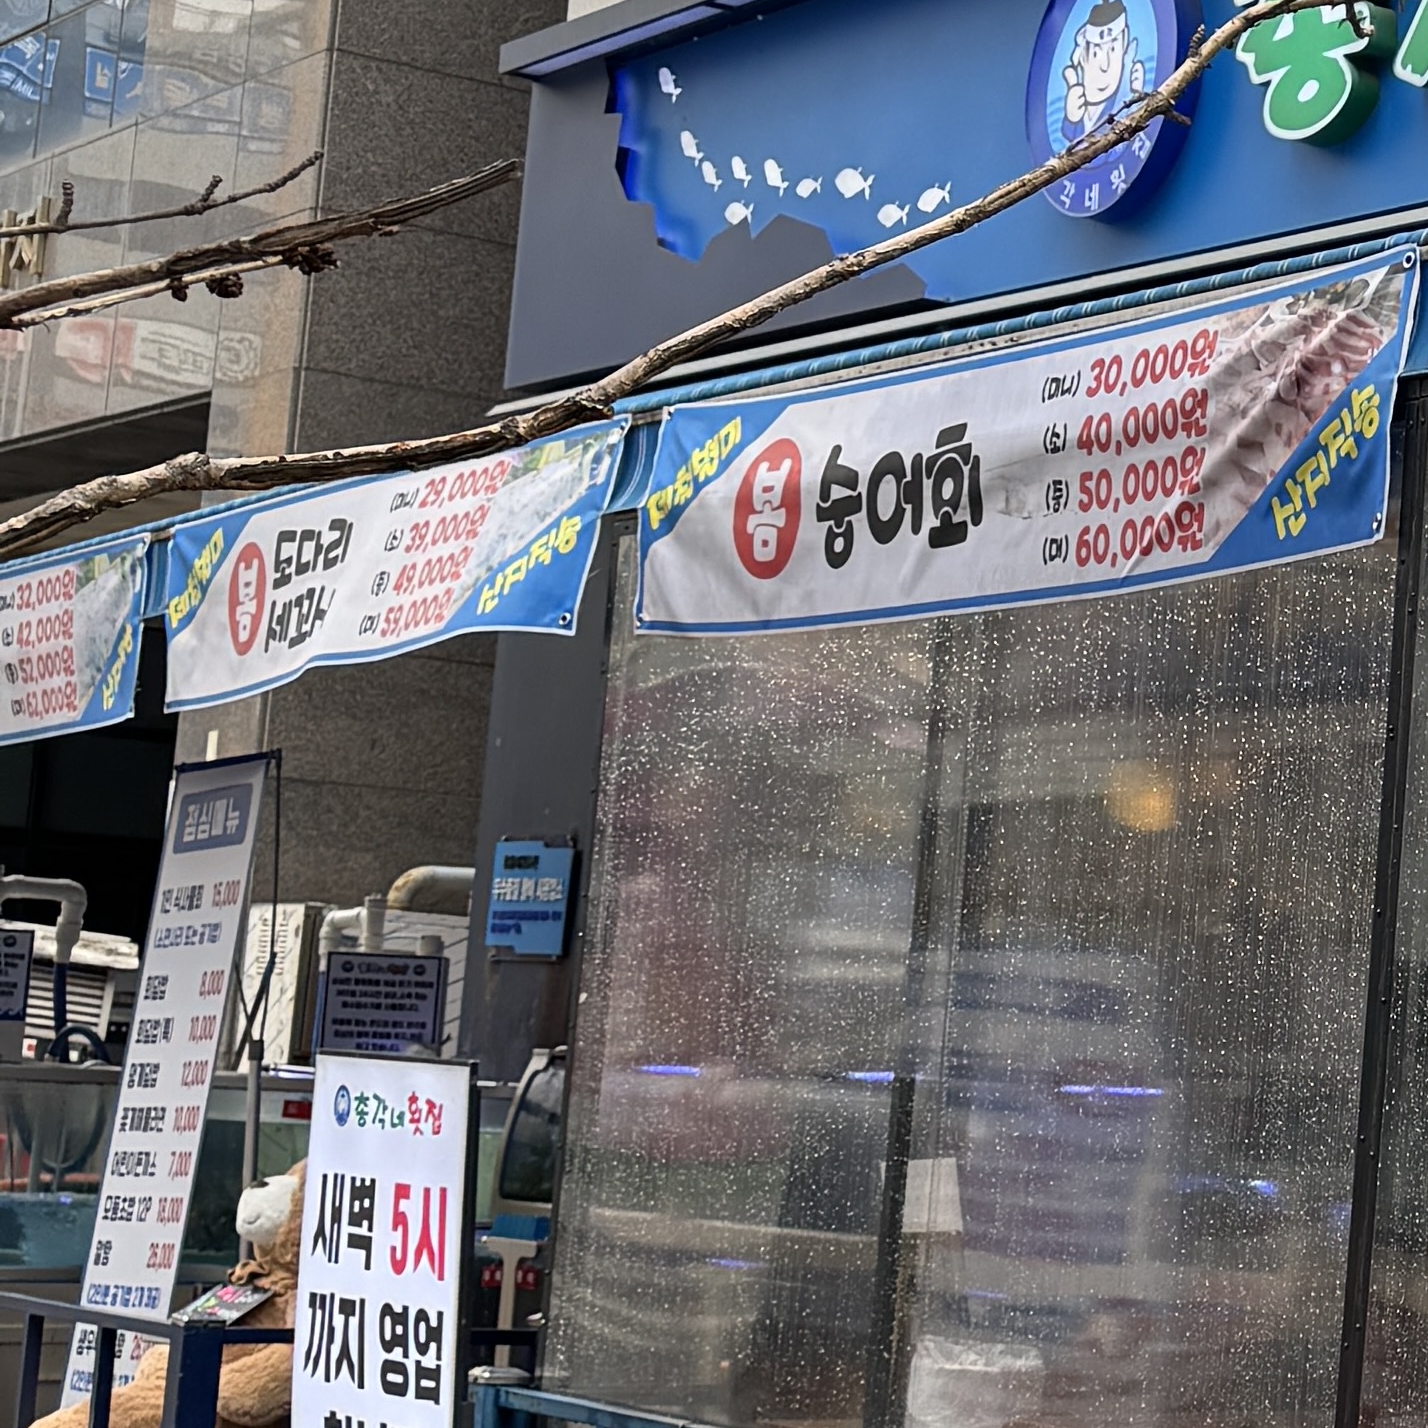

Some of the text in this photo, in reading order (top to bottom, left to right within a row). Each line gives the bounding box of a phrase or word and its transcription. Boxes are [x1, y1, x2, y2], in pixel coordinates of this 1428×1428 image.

[1041, 328, 1220, 404] (미니) 30,000원
[1043, 387, 1209, 457] (소) 40,000원
[417, 459, 513, 511] 29,000원
[1045, 444, 1207, 514] (중) 50,000원
[1270, 384, 1383, 542] 산지직송
[750, 422, 983, 571] 봄 숭어회
[404, 503, 492, 555] 39,000원
[1074, 500, 1206, 569] 60,000원
[16, 568, 75, 612] 32,000원
[235, 517, 354, 643] 봄 도다리
[392, 545, 473, 597] 49,000원
[16, 608, 74, 649] 42,000원
[379, 587, 455, 639] 59,000원
[18, 644, 75, 685] 52,000원
[26, 680, 78, 720] 62,000원
[354, 1090, 405, 1130] 총각네
[407, 1091, 444, 1136] 횟집
[311, 1173, 448, 1282] 새벽 5시
[304, 1290, 367, 1390] 까지
[378, 1303, 445, 1406] 영업
